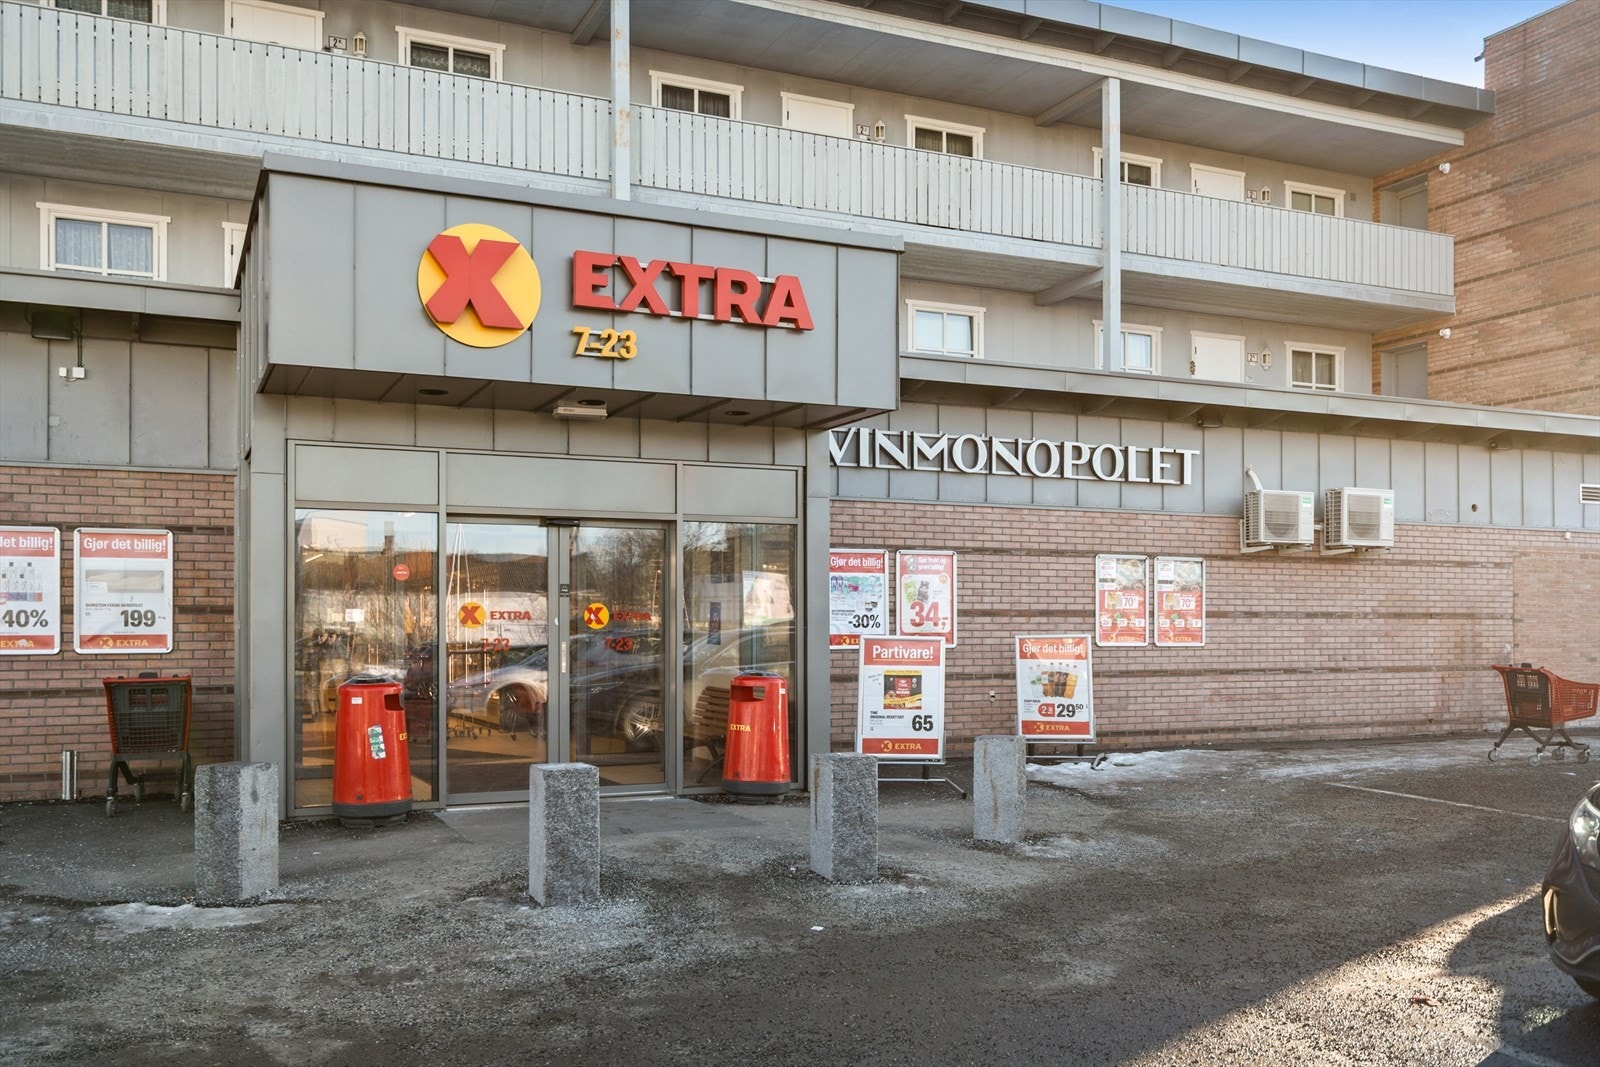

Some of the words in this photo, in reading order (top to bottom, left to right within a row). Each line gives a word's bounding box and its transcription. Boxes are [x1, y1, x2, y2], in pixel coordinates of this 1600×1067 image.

[573, 250, 815, 331] EXTRA
[572, 326, 638, 360] 7-23
[829, 427, 1200, 485] VINMONOPOLET
[19, 536, 54, 551] billig!
[83, 537, 109, 551] Gjør
[111, 539, 132, 549] det
[134, 539, 166, 552] billig!
[830, 556, 846, 568] Gjør
[848, 557, 861, 566] det
[862, 557, 884, 568] billig!
[120, 609, 156, 627] 199
[490, 611, 532, 621] EXTRA
[613, 611, 652, 621] EXTRA
[848, 614, 881, 628] -30%
[1, 639, 34, 647] EXTA
[116, 639, 149, 647] EXTRA
[481, 637, 510, 651] 7-23
[605, 637, 632, 651] 7-23
[1022, 643, 1040, 654] Gjør
[1042, 644, 1057, 653] det
[872, 645, 934, 659] Partivare!
[730, 723, 751, 732] EXTRA
[912, 715, 934, 731] 65
